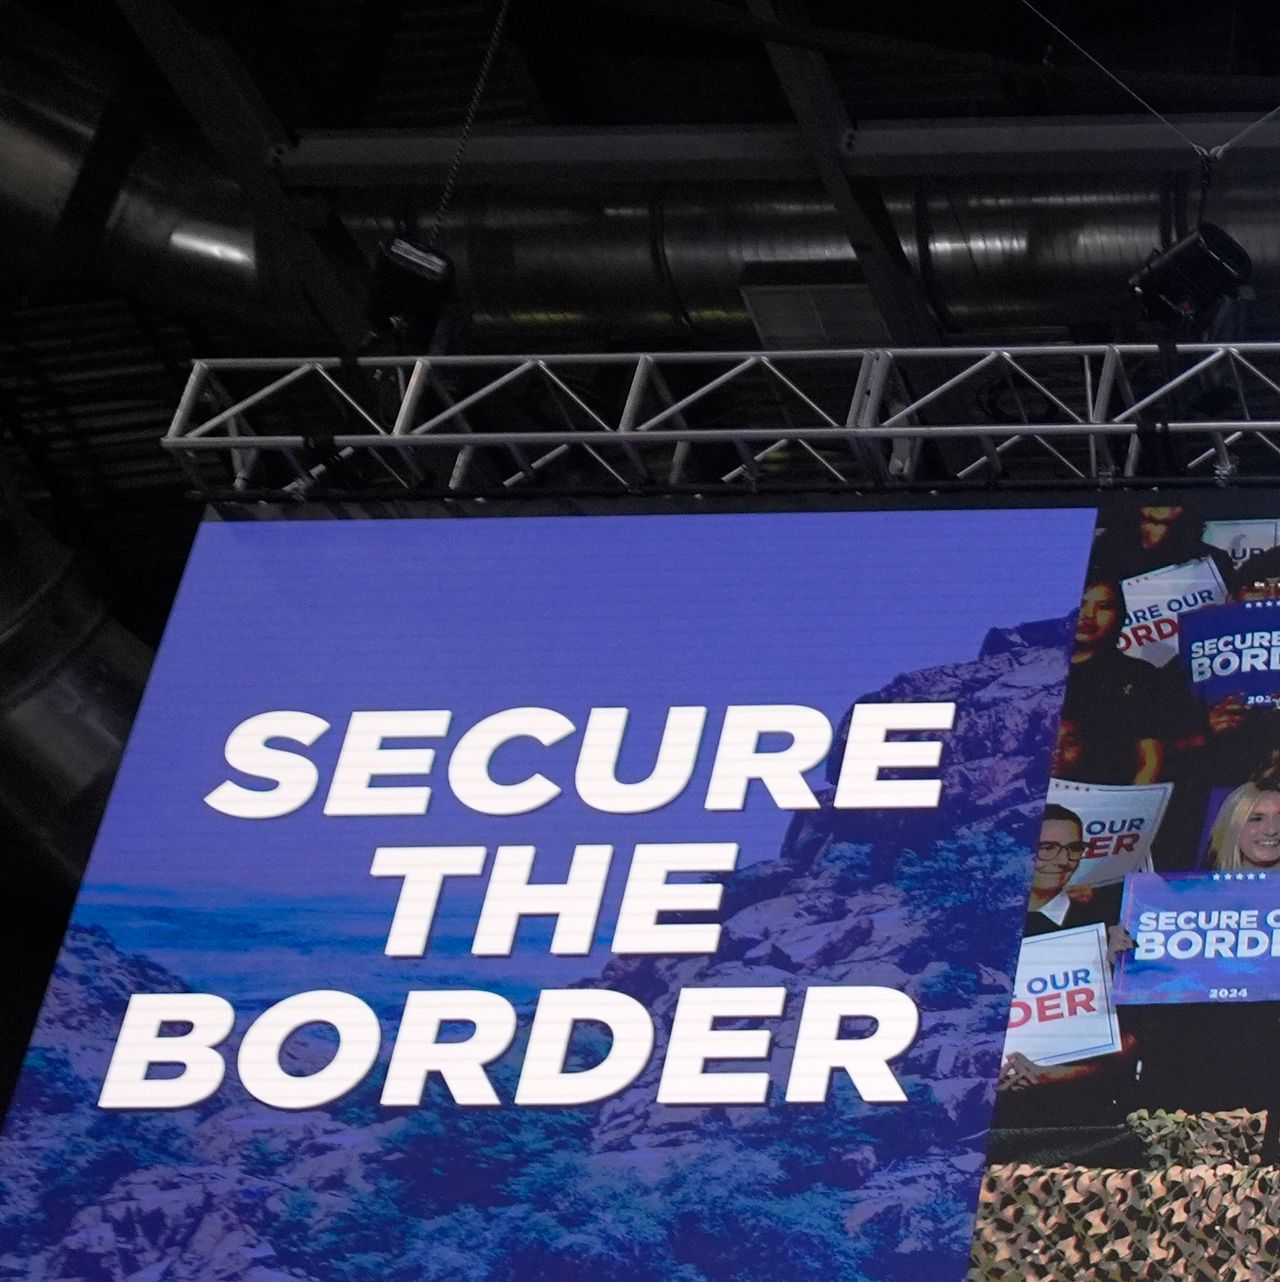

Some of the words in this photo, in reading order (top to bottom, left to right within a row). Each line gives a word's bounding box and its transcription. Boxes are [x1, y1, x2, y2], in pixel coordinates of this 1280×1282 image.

[1167, 588, 1214, 613] OUR
[1116, 617, 1178, 652] ORD
[203, 701, 956, 820] SECURE
[1085, 817, 1146, 836] OUR
[369, 842, 739, 957] THE
[1138, 909, 1259, 932] SECURE
[1027, 967, 1091, 995] OUR
[1208, 987, 1248, 999] 2024
[1008, 988, 1097, 1030] DER
[97, 985, 921, 1110] BORDER
